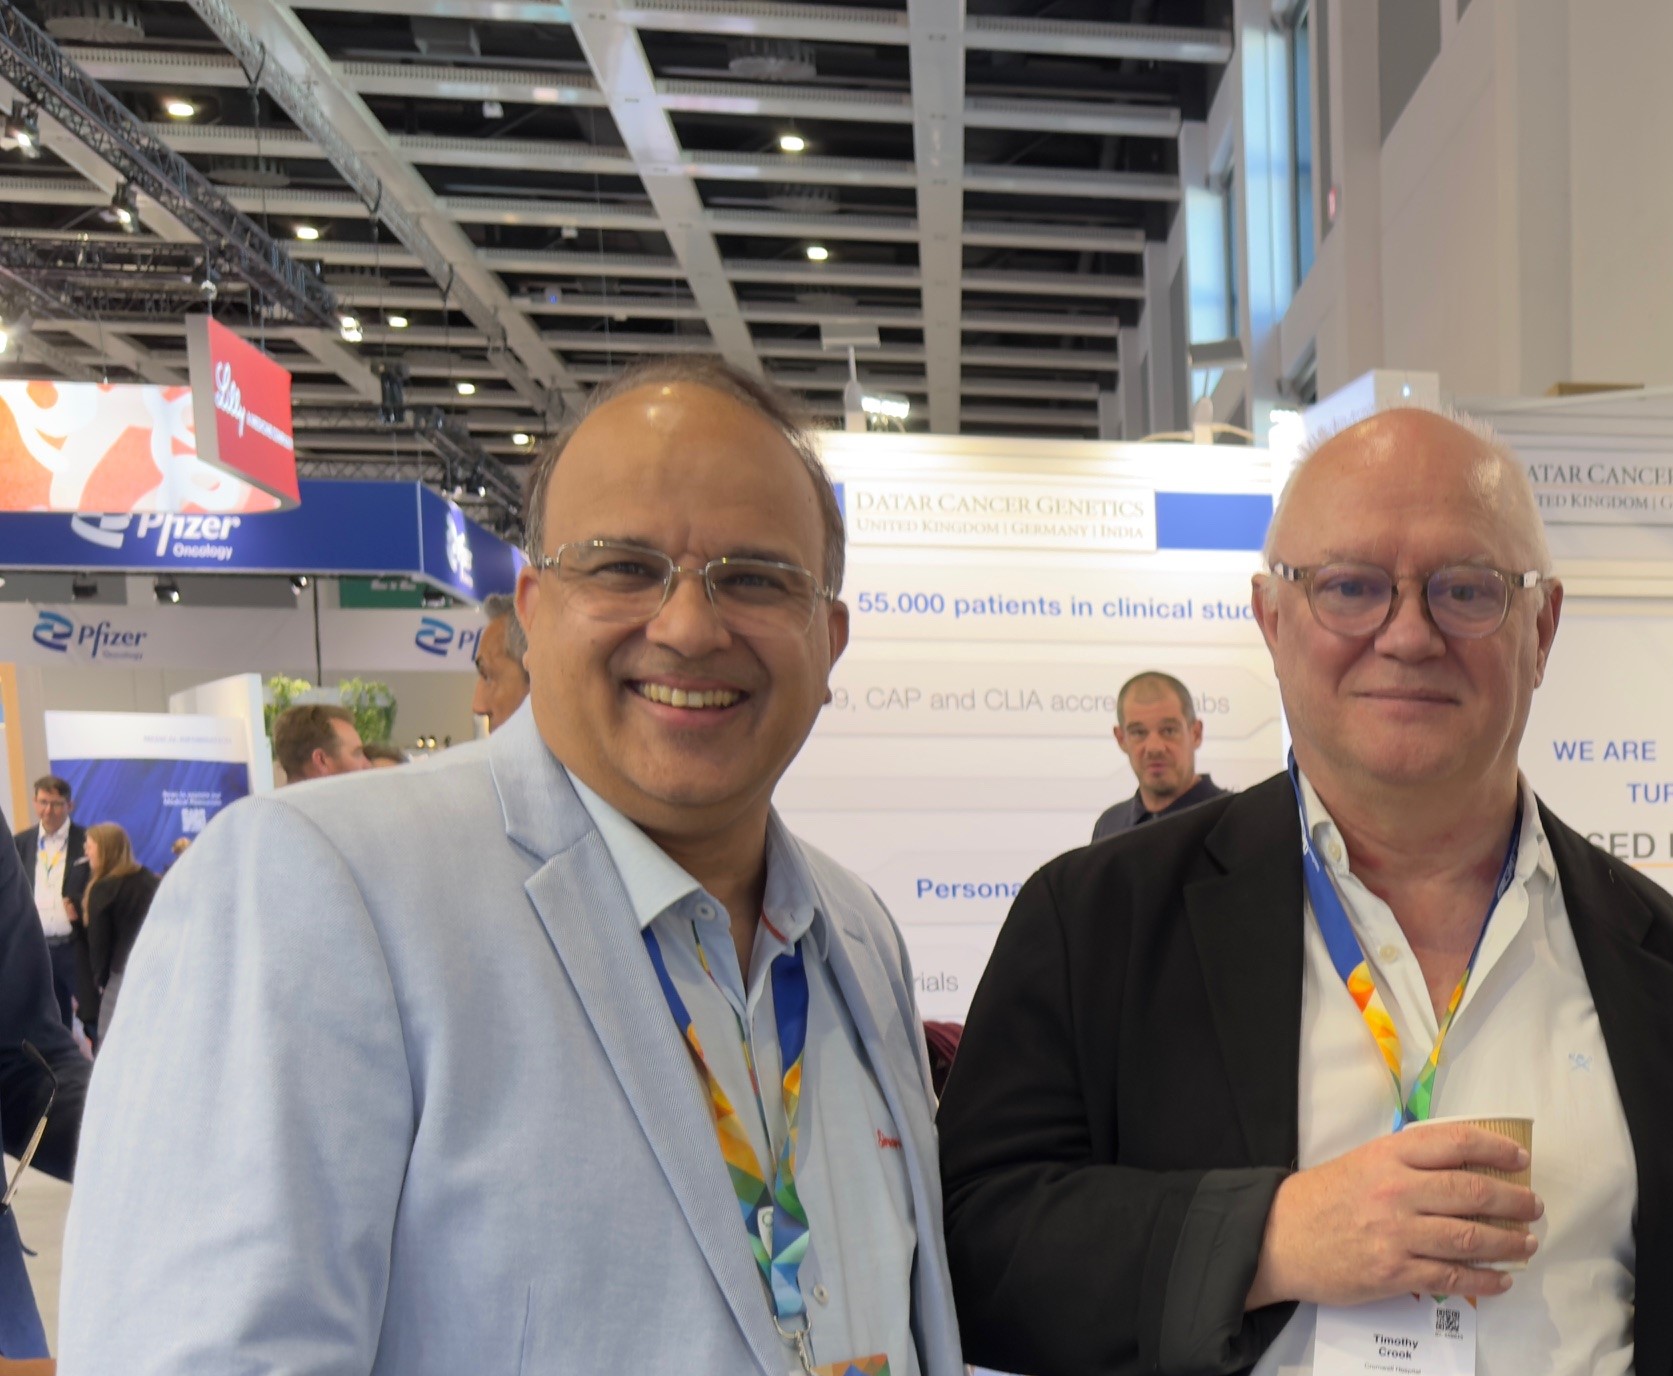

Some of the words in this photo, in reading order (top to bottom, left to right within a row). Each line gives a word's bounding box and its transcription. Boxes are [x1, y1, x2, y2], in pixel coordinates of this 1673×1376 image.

[1526, 464, 1582, 484] ATAR
[856, 491, 937, 513] DATAR
[938, 493, 1032, 516] CANCER
[1036, 495, 1145, 519] GENETICS
[1570, 493, 1648, 510] KINGDOM
[858, 592, 945, 614] 55.000
[954, 594, 1061, 618] patients
[1071, 596, 1093, 617] in
[1102, 595, 1192, 619] clinical
[78, 621, 147, 658] Pfizer
[866, 686, 921, 711] CAP
[931, 688, 976, 711] and
[984, 688, 1043, 712] CLIA
[1553, 741, 1594, 762] WE
[1603, 741, 1657, 762] ARE
[1373, 1333, 1419, 1350] Timothy
[1378, 1347, 1412, 1360] Crook
